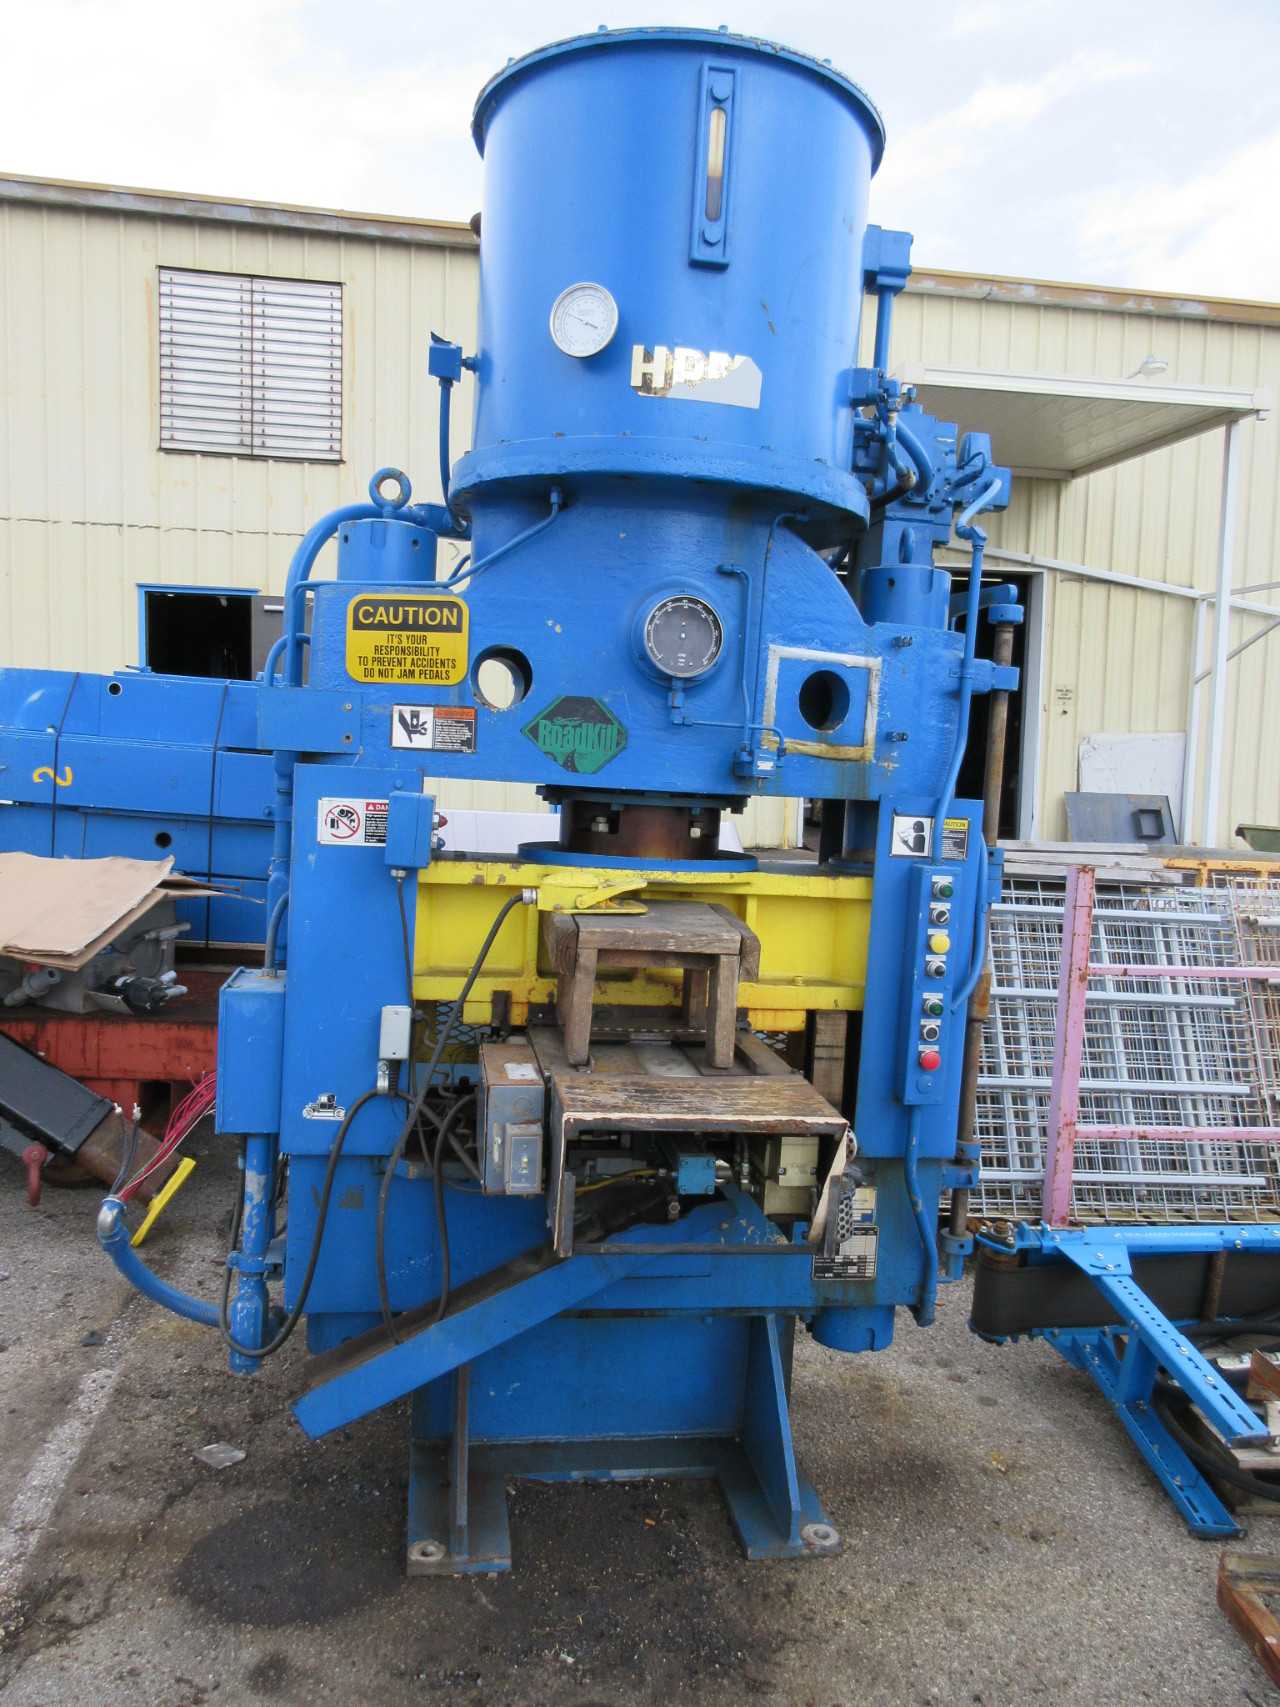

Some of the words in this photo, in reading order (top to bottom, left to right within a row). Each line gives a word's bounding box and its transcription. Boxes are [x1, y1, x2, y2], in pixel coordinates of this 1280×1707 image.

[358, 605, 458, 626] CAUTION
[386, 634, 403, 645] IT'S
[406, 634, 428, 645] YOUR
[374, 645, 440, 657] RESPONSIBILITY
[358, 656, 369, 667] TO
[371, 656, 407, 668] PREVENT
[410, 657, 457, 669] ACCIDENTS
[363, 667, 375, 678] DO
[378, 668, 394, 679] NOT
[397, 669, 416, 679] JAM
[418, 669, 450, 681] PEDALS
